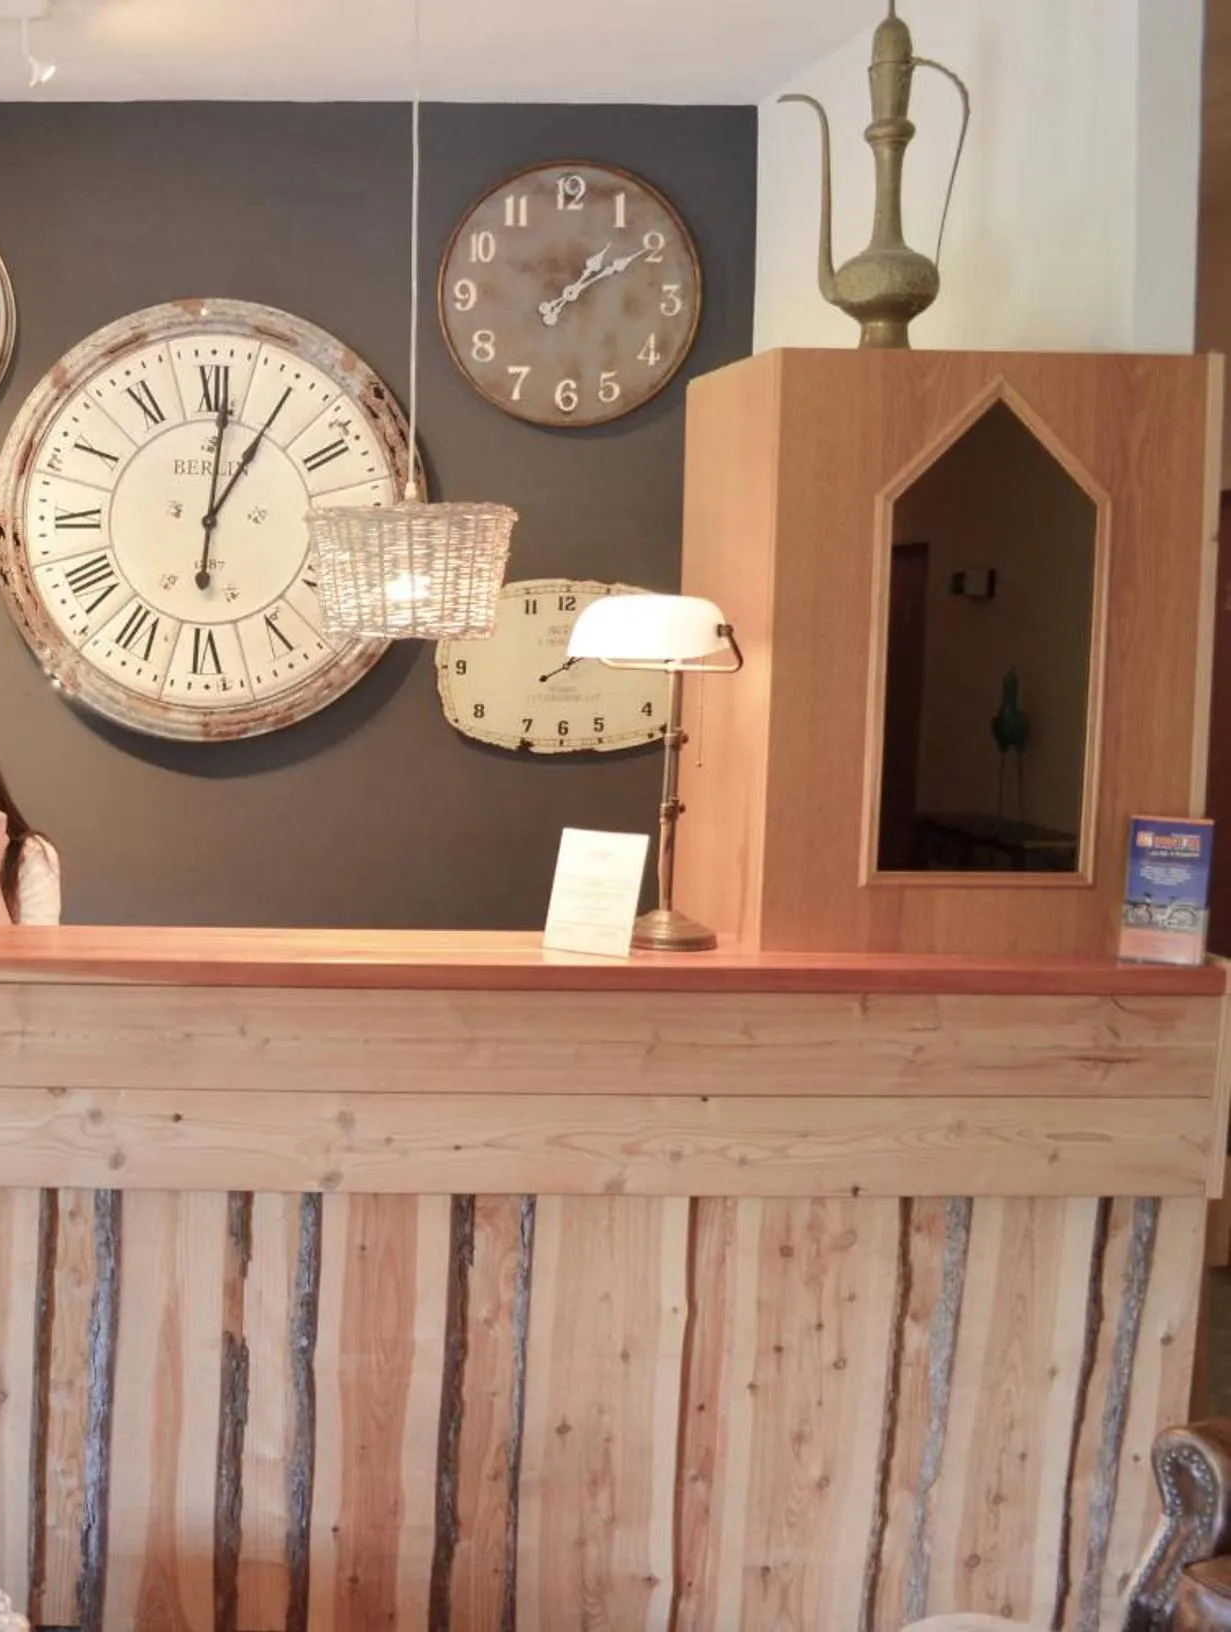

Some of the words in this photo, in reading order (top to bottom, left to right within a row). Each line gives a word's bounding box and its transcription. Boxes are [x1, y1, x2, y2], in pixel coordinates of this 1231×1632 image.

[556, 175, 586, 211] 12
[504, 195, 528, 227] 11
[613, 192, 627, 228] 1
[470, 232, 496, 263] 10
[643, 232, 665, 263] 2
[454, 279, 477, 311] 9
[660, 284, 682, 316] 3
[472, 330, 496, 362] 8
[637, 333, 660, 366] 4
[507, 366, 531, 400] 7
[555, 380, 578, 411] 6
[598, 372, 620, 402] 5
[525, 600, 537, 614] 11
[558, 597, 576, 612] 12
[456, 660, 467, 674] 9
[474, 704, 484, 718] 8
[641, 702, 652, 716] 4
[522, 719, 533, 732] 7
[558, 721, 568, 735] 6
[594, 718, 604, 732] 5
